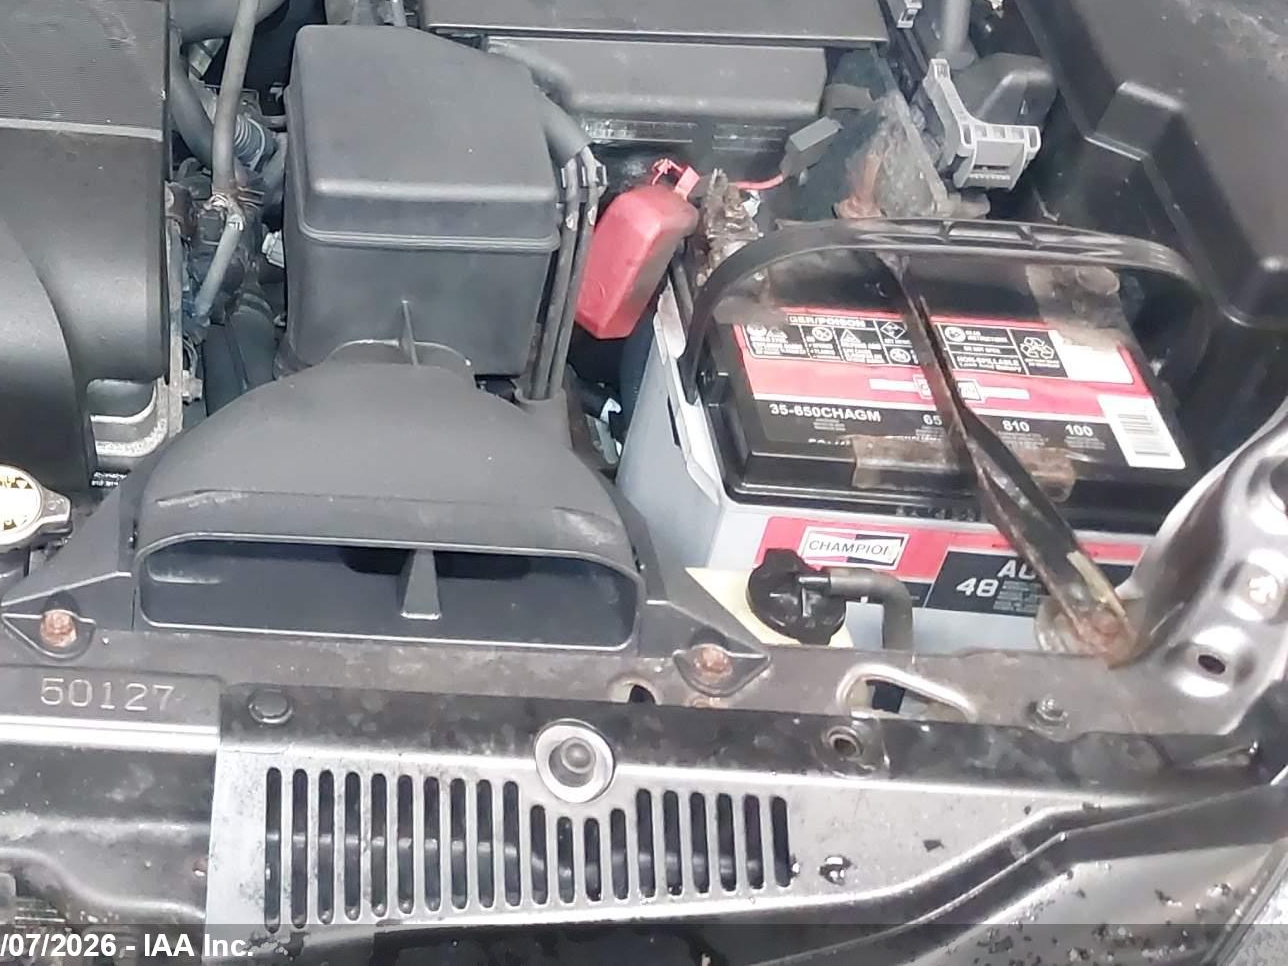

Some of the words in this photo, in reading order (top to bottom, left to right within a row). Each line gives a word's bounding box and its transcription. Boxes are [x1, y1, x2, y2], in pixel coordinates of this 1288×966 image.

[788, 315, 867, 328] GER/POISON
[768, 403, 881, 423] 35-650CHAGM
[923, 414, 943, 425] 65
[1002, 421, 1030, 432] 810
[1065, 424, 1093, 437] 100
[956, 577, 999, 598] 48
[40, 677, 175, 712] 50127
